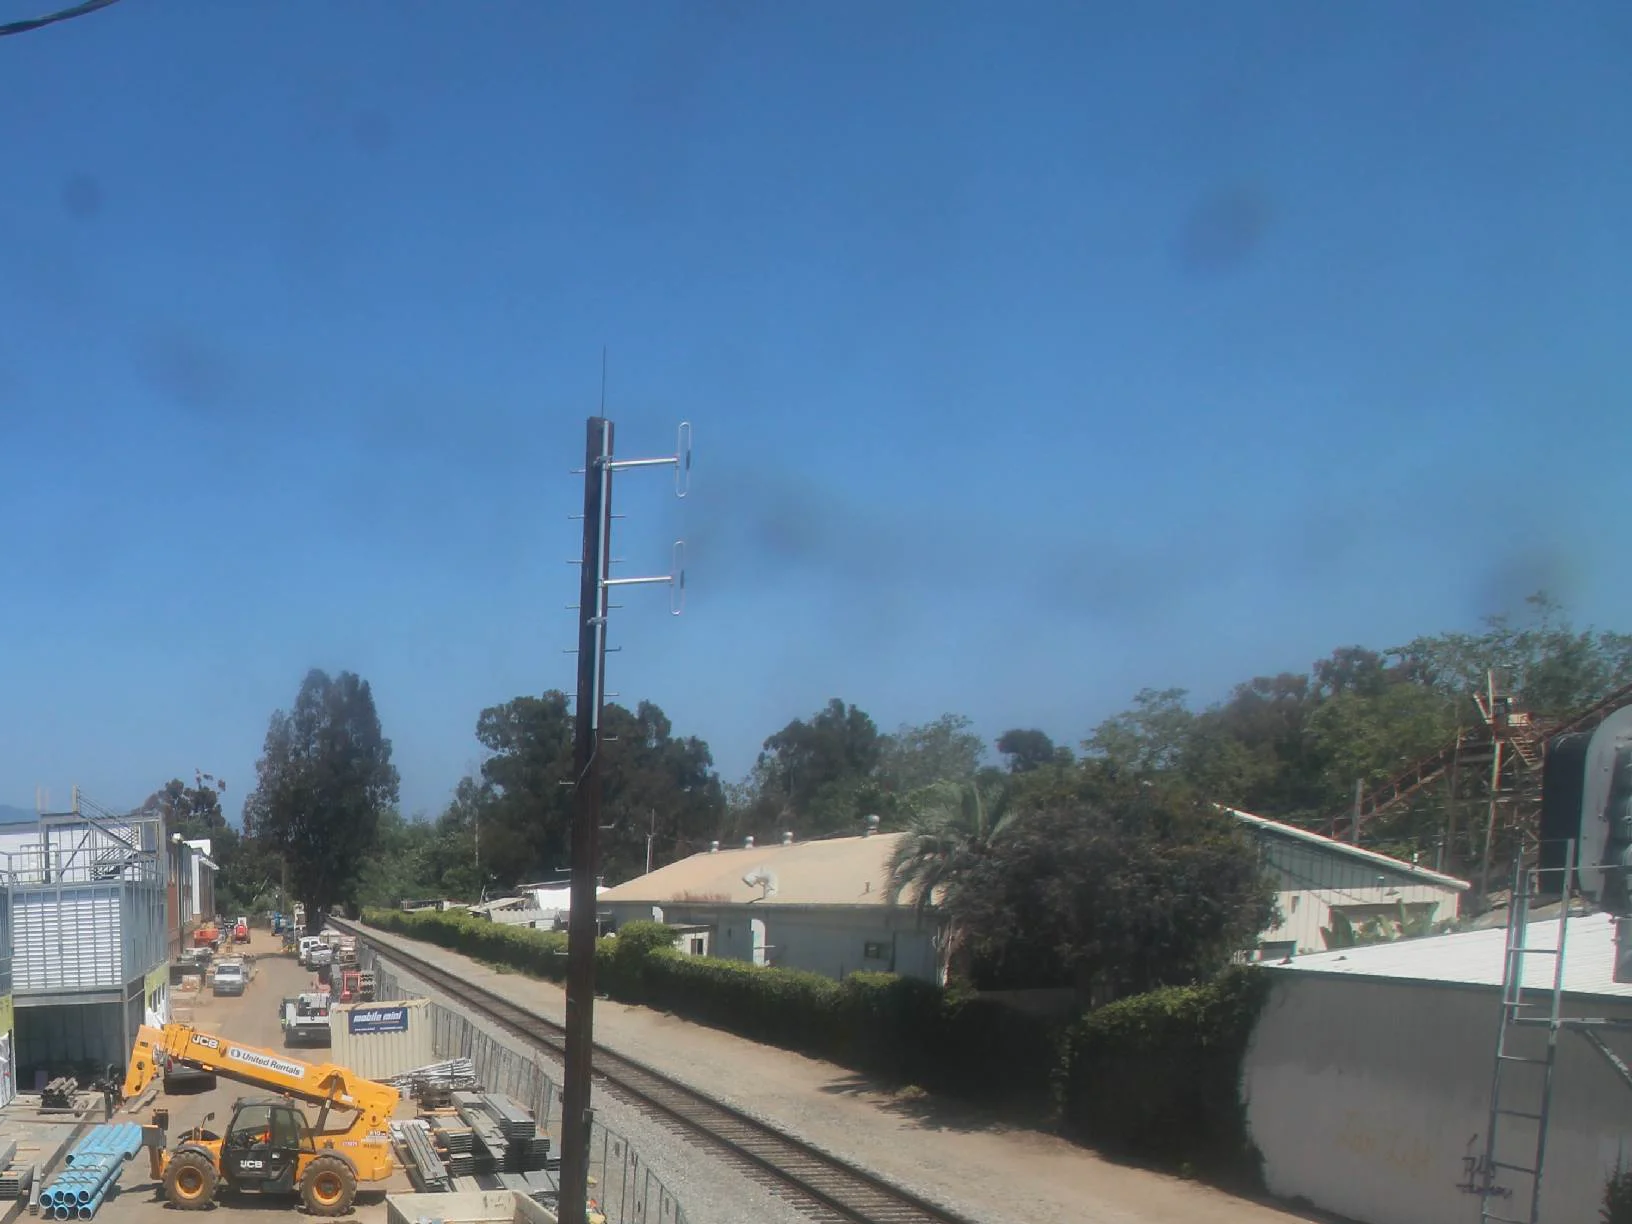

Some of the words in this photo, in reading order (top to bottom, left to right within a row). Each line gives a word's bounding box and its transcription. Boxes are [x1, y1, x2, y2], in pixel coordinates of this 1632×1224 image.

[192, 1034, 219, 1049] JCB
[242, 1052, 269, 1066] United
[270, 1060, 300, 1075] Rentals
[240, 1160, 263, 1168] JCB
